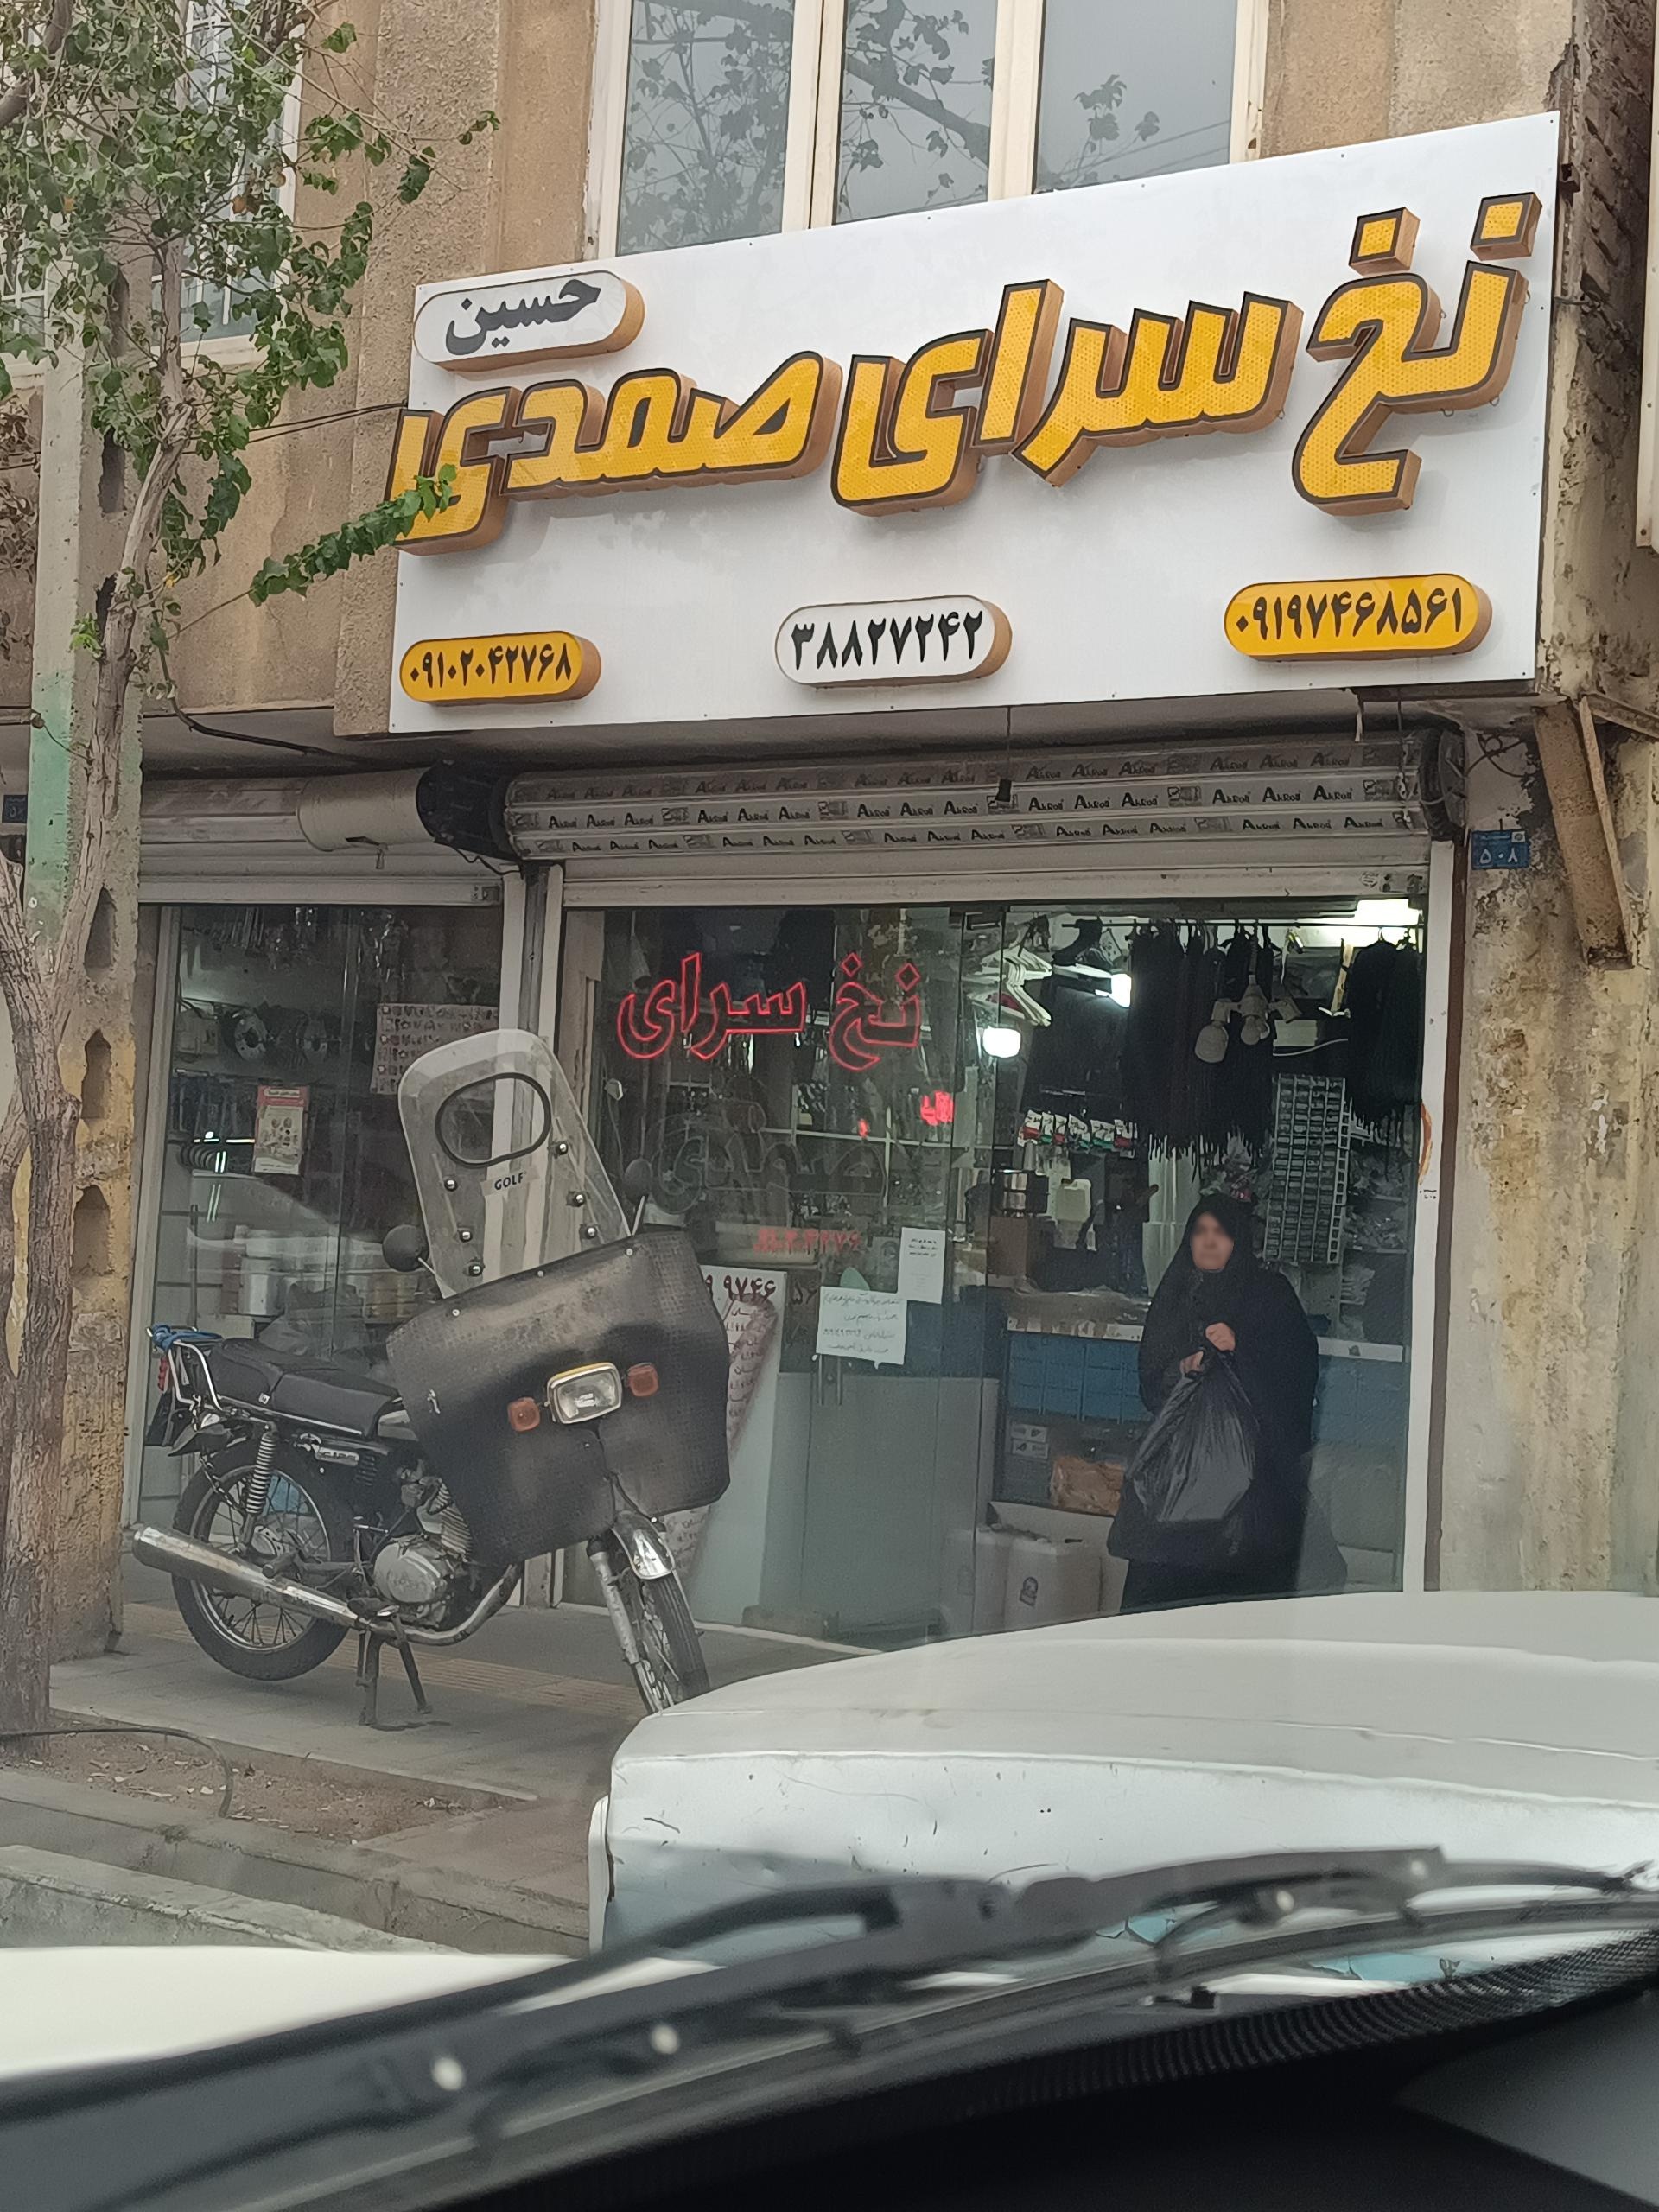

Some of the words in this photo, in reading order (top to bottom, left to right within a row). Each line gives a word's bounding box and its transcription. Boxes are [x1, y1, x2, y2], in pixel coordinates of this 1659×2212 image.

[444, 274, 601, 357] حسین
[1293, 192, 1538, 504] نخ
[830, 278, 1296, 508] سرای
[385, 351, 827, 546] صمدی
[791, 610, 984, 671] ۳۸۸۲۷۲۴۲
[1236, 587, 1463, 639] ۰۹۱۹۷۴۶۸۵۶۱
[409, 642, 573, 689] ۰۹۱۰۲۰۴۲۷۶۸
[1479, 847, 1518, 864] ۵۰۸
[617, 952, 808, 1059] سرای
[830, 952, 921, 1071] نخ
[494, 1172, 524, 1191] GOLF
